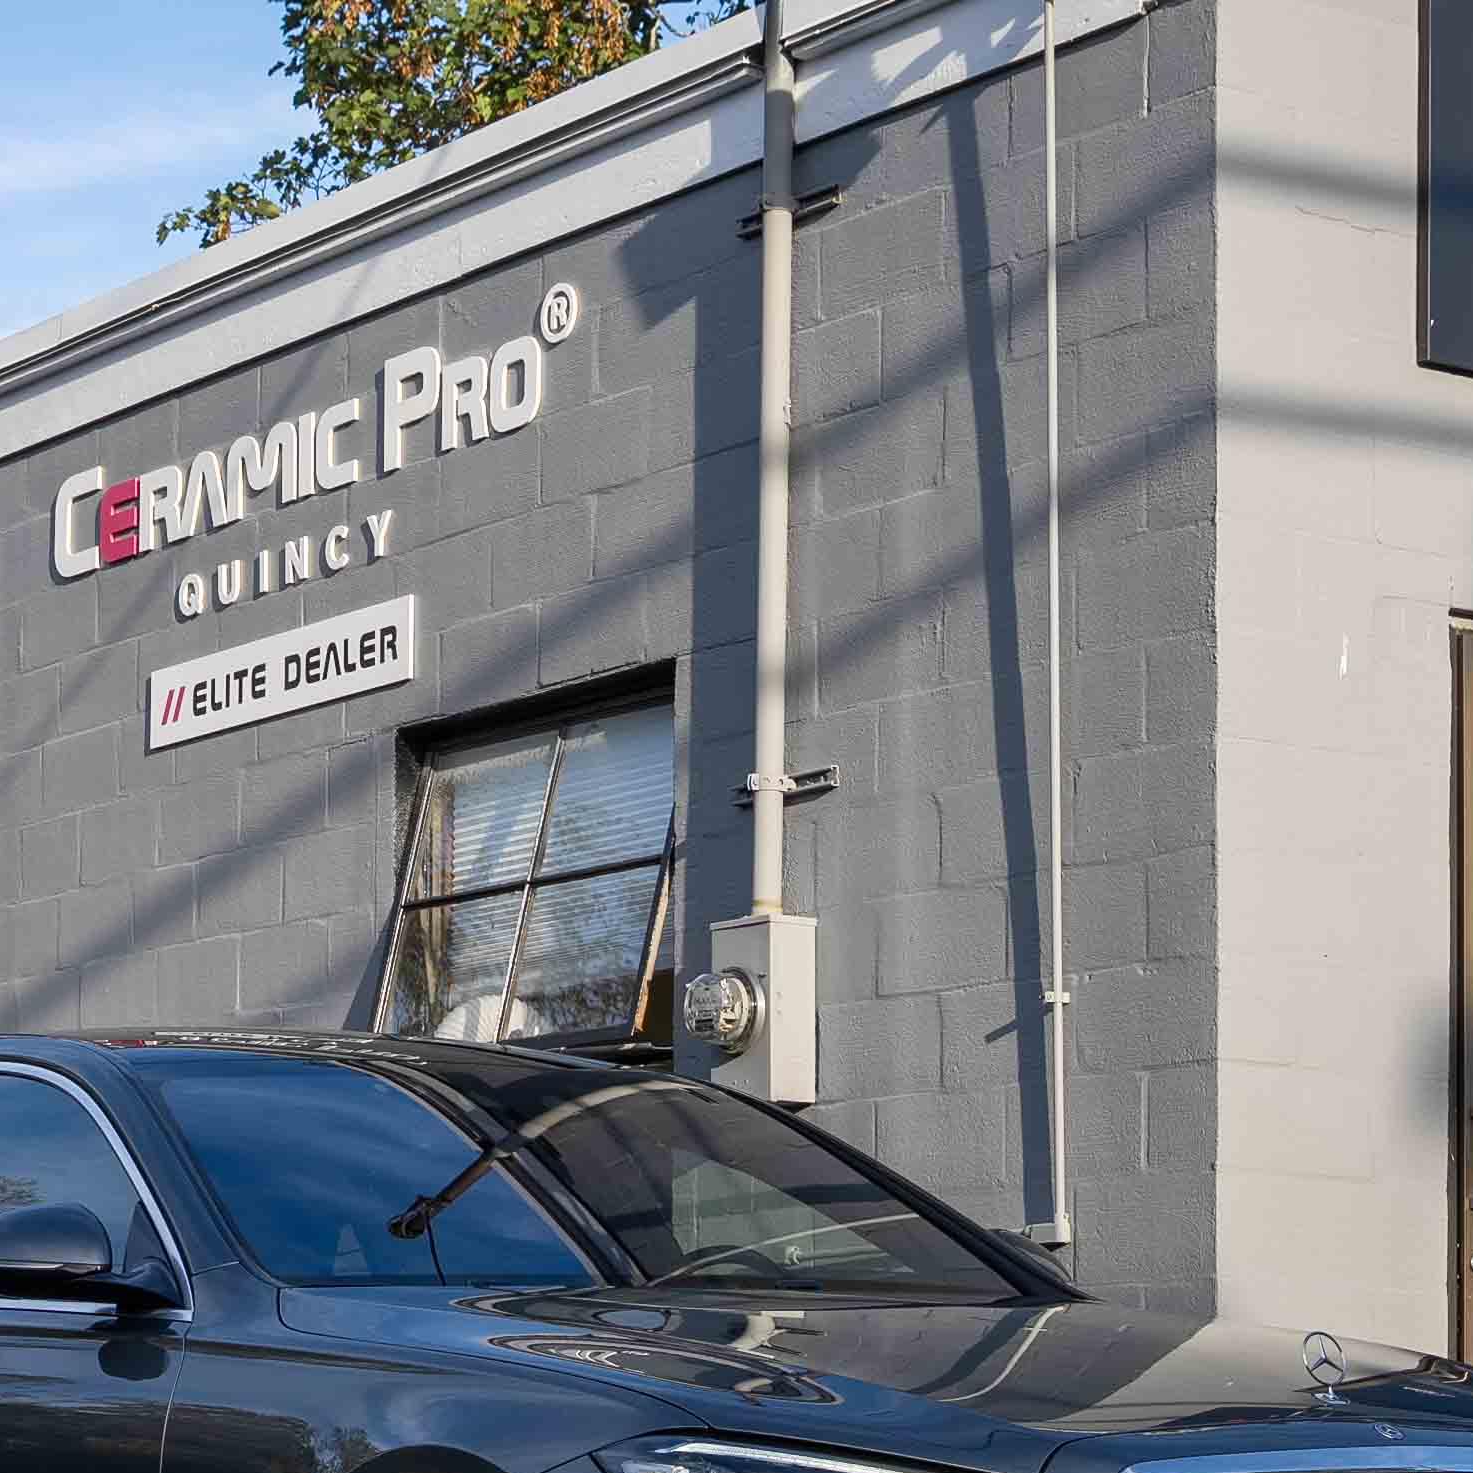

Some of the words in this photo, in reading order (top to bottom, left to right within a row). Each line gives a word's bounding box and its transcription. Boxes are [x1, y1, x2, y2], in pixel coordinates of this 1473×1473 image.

[53, 398, 360, 578] CERAMIC
[178, 509, 393, 617] QUINCY
[192, 663, 267, 717] ELITE
[284, 625, 399, 691] DEALER
